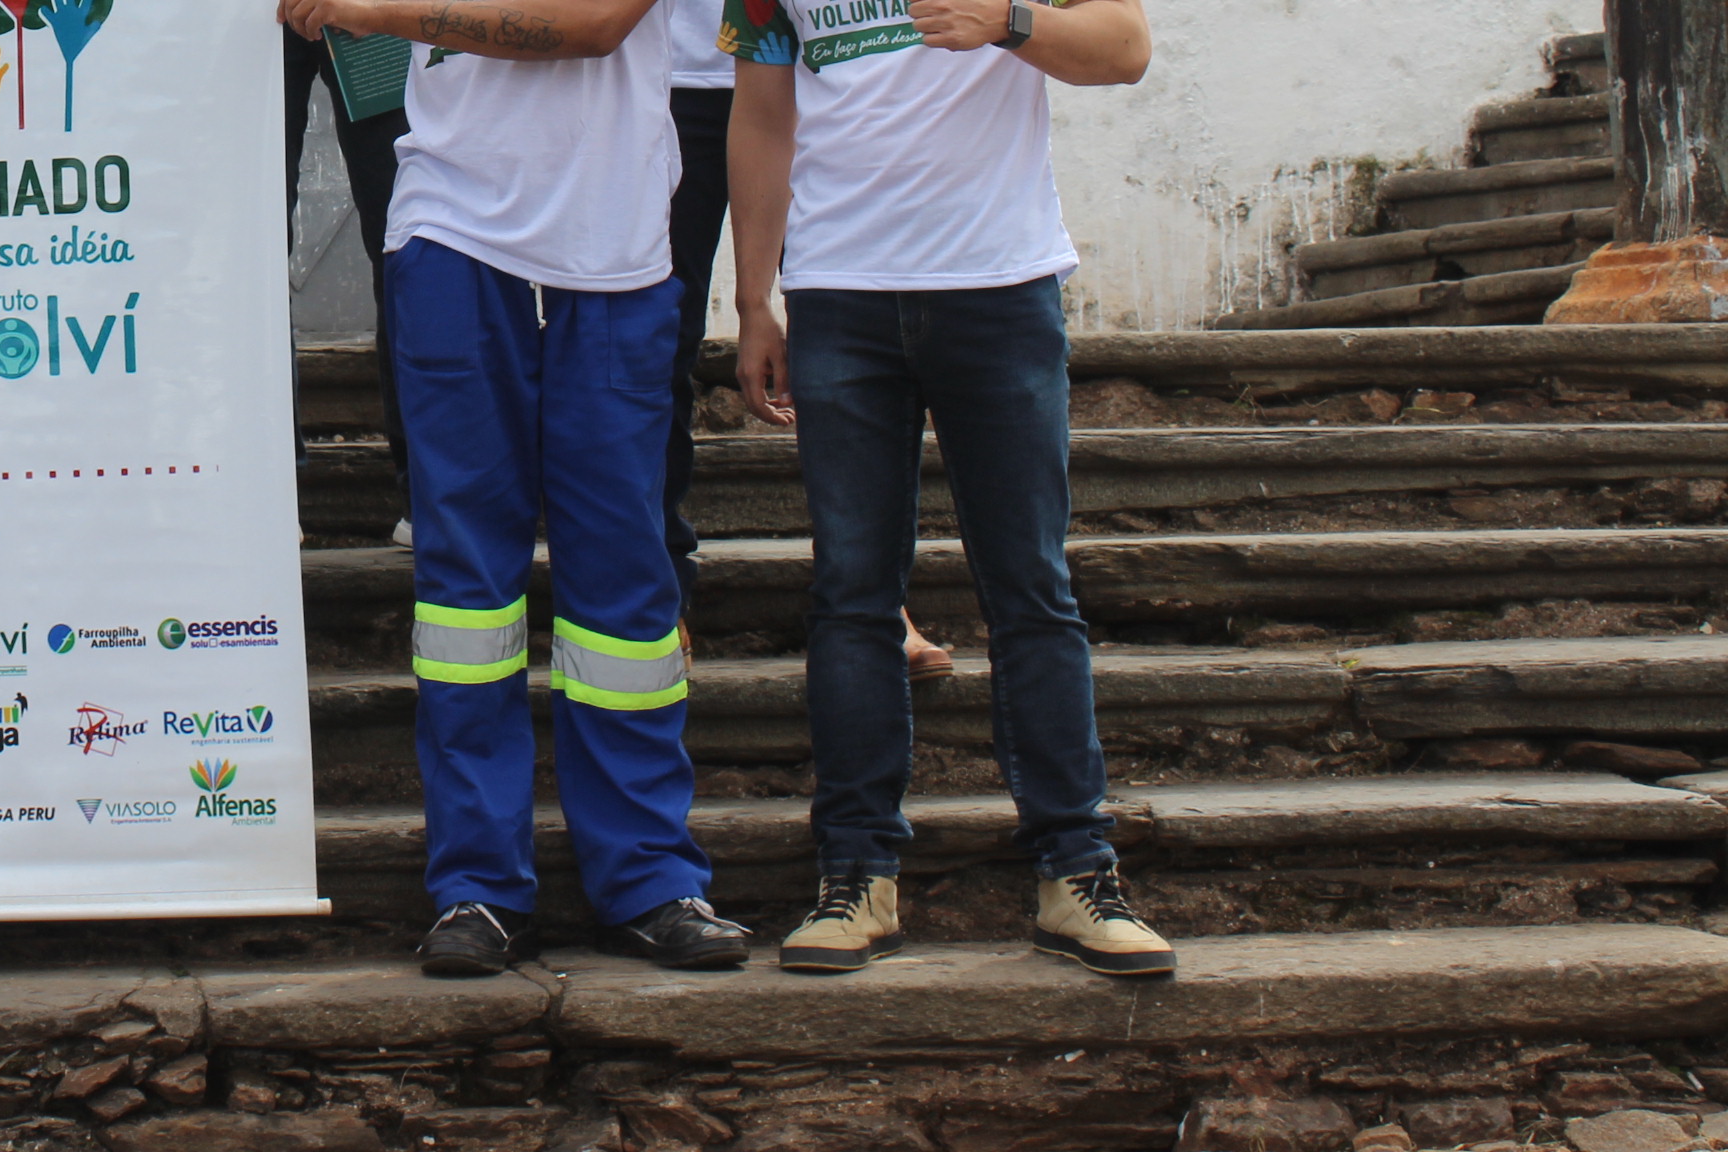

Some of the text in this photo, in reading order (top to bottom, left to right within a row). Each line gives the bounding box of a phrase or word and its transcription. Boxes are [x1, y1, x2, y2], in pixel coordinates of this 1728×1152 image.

[812, 43, 832, 61] Eu
[834, 40, 857, 58] faço
[859, 32, 890, 53] parte
[49, 225, 135, 265] idéia
[78, 626, 139, 640] Farroupilha
[188, 615, 278, 638] essencis
[91, 636, 147, 648] Ambiental
[163, 710, 243, 738] ReVita
[191, 736, 274, 746] engenharia sustentável
[106, 801, 176, 816] VIASOLO
[195, 793, 277, 817] Alfenas
[18, 806, 56, 821] PERU
[232, 816, 276, 826] Ambiental
